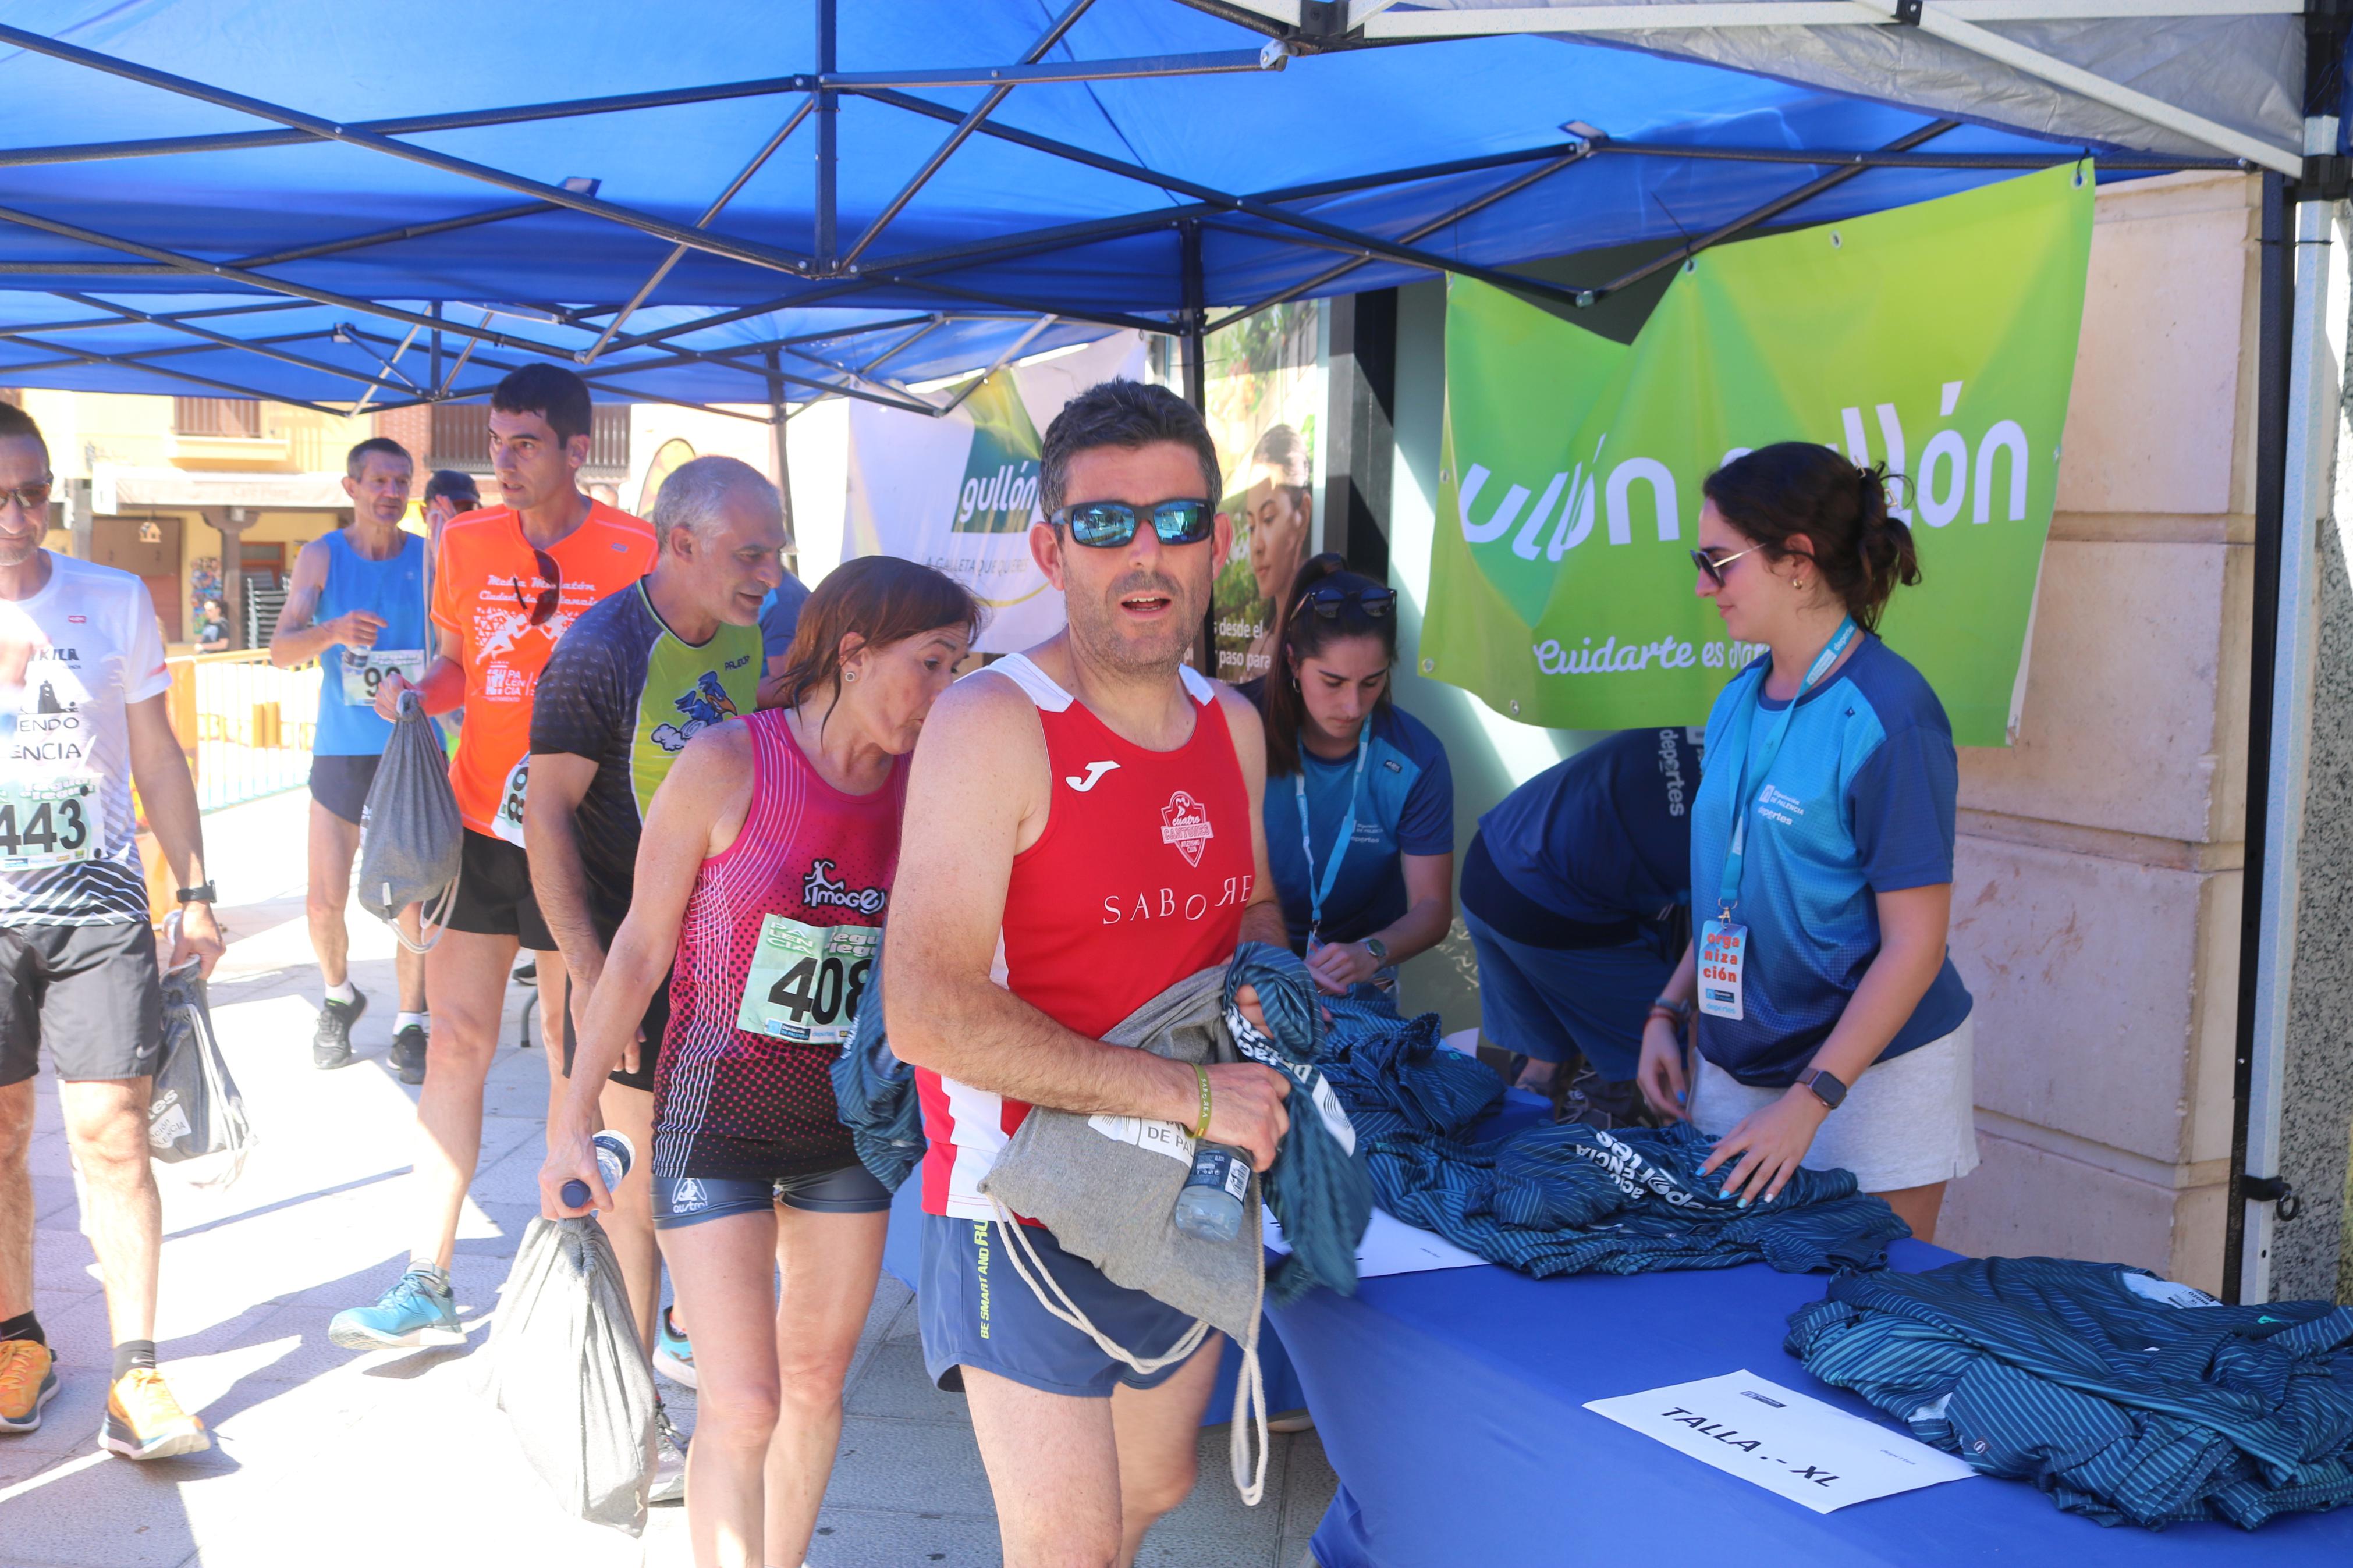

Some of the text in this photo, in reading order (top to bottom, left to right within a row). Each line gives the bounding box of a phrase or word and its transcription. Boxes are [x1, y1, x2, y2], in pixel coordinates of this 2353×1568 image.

[1720, 380, 2029, 529] llón
[960, 460, 1037, 522] gullón
[487, 574, 526, 588] Meda
[1219, 617, 1264, 638] desde el
[1219, 650, 1272, 672] paso para
[1532, 635, 1697, 675] Cuidarte
[1702, 641, 1724, 668] es
[1658, 728, 1685, 817] deportes
[0, 798, 86, 855] 443
[768, 929, 814, 948] LEN
[771, 922, 807, 939] PA
[767, 937, 814, 955] CIA
[1707, 933, 1740, 950] orga
[1703, 948, 1738, 965] niza
[1703, 966, 1737, 983] ción
[767, 956, 874, 1026] 408
[1147, 1126, 1170, 1144] DE
[977, 1247, 989, 1275] AND
[978, 1274, 989, 1321] SMART
[980, 1321, 989, 1339] BE
[1788, 1465, 1840, 1487] XL
